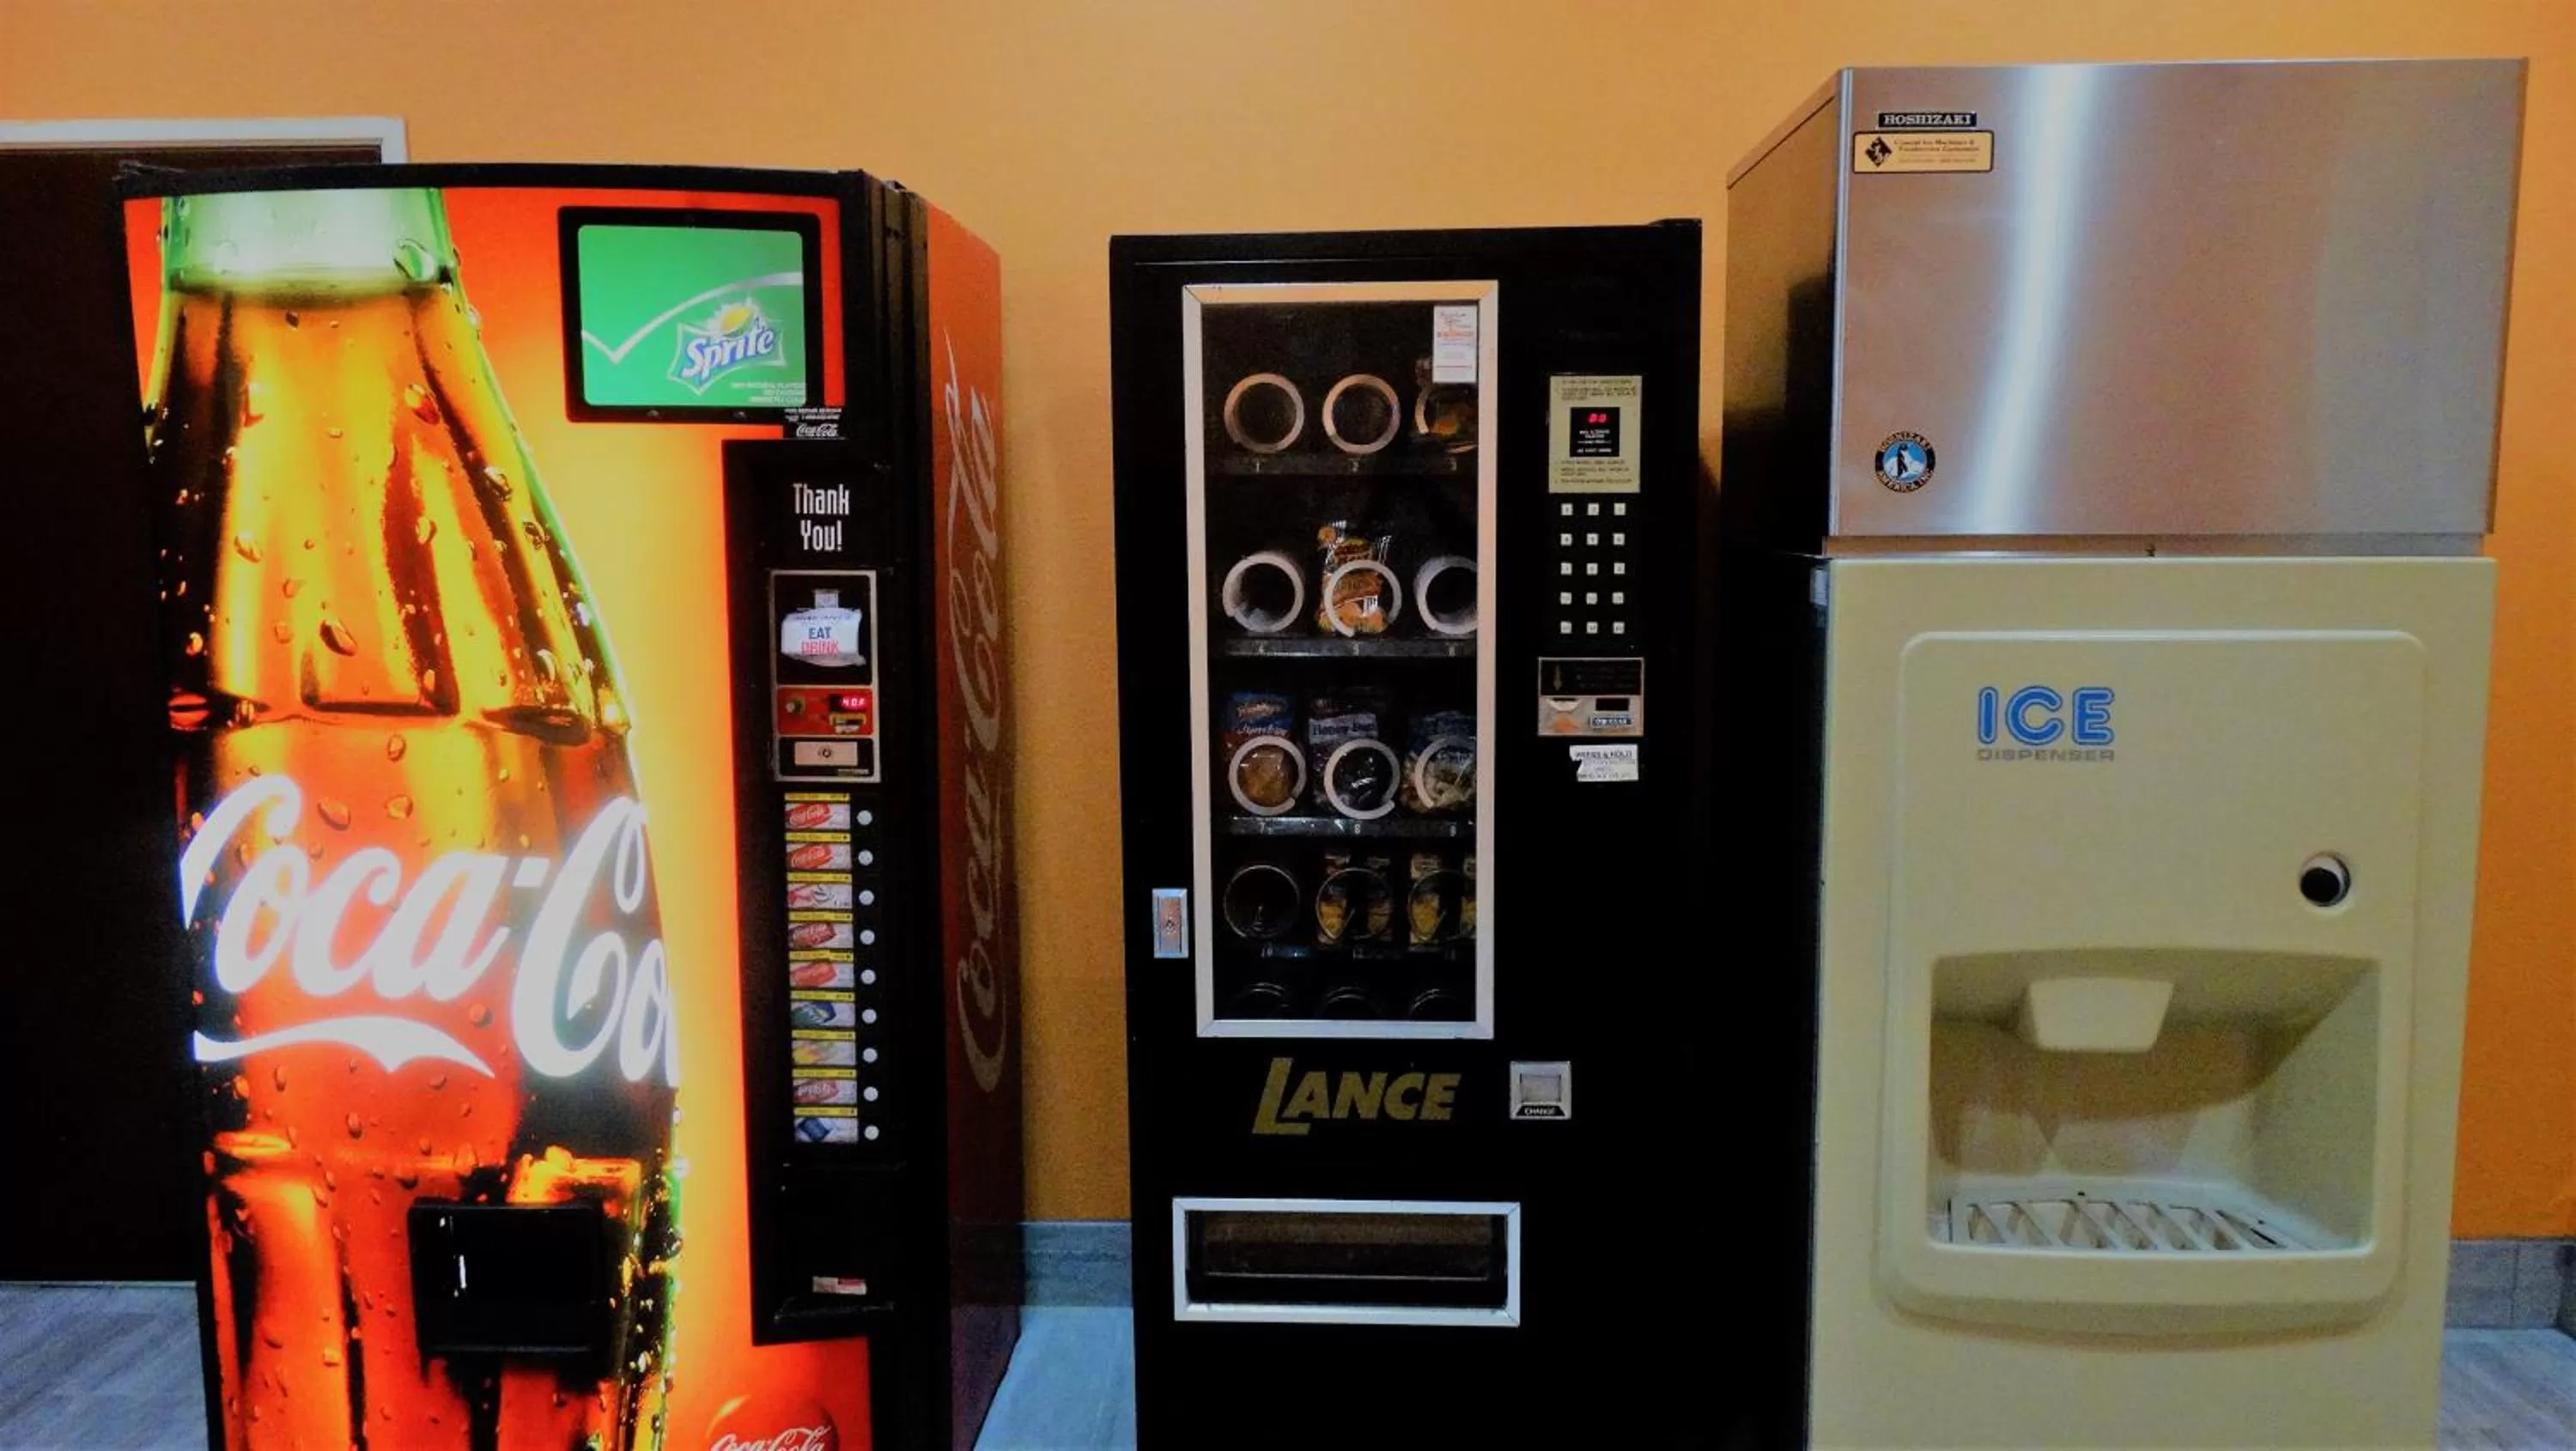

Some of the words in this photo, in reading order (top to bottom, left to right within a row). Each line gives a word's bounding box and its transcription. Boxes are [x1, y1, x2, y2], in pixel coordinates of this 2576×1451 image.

[1884, 113, 1971, 126] HOSHIZAKI
[681, 316, 775, 387] Sprite
[793, 483, 851, 516] Thank
[799, 519, 843, 552] You!
[808, 627, 832, 640] EAT
[944, 330, 1007, 1092] Coca-Cola
[1978, 685, 2115, 745] ICE
[1978, 749, 2115, 762] DISPENSER
[179, 773, 680, 1089] Coca-Co
[1252, 1057, 1462, 1135] LANCE
